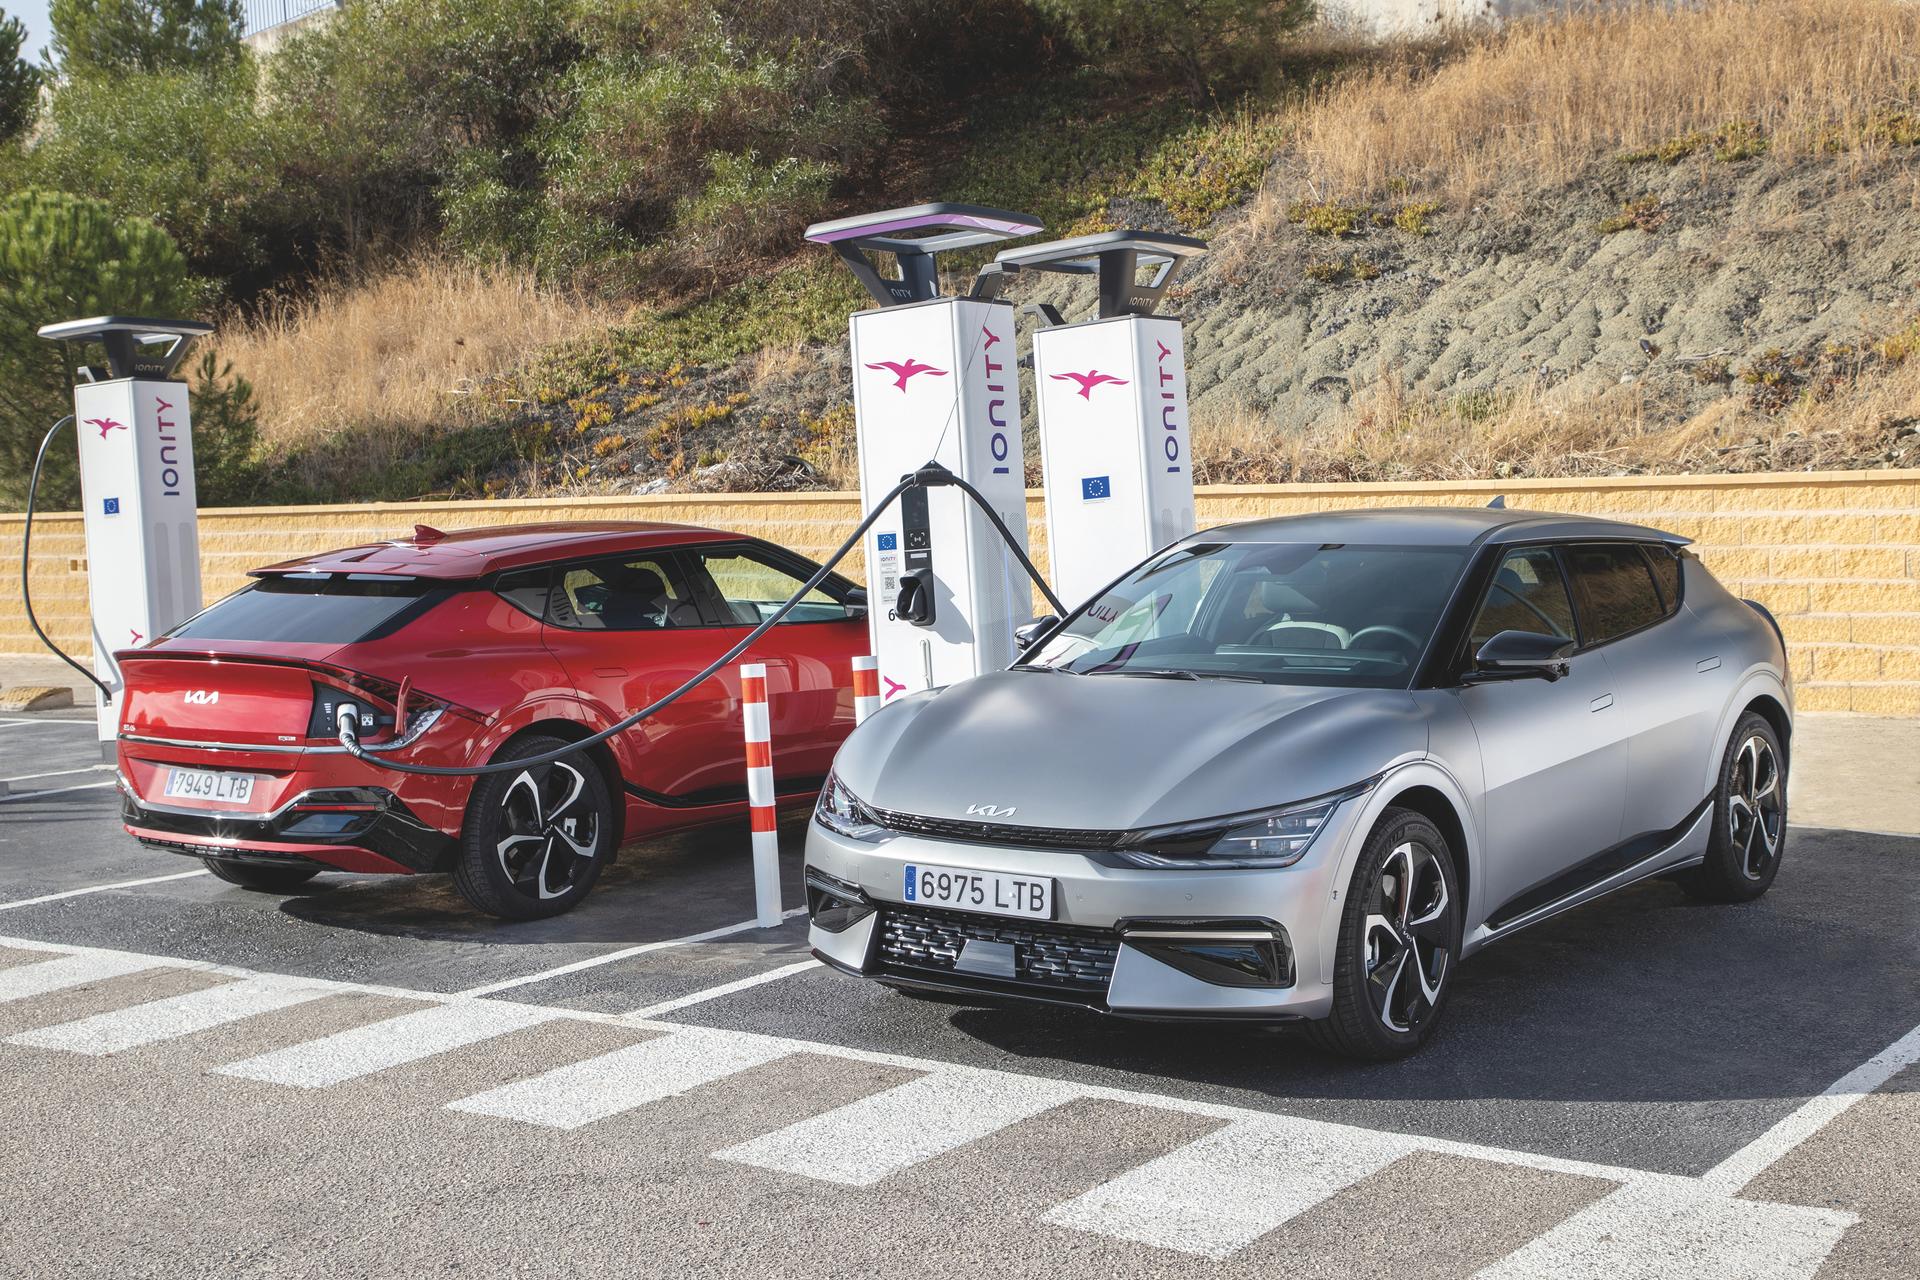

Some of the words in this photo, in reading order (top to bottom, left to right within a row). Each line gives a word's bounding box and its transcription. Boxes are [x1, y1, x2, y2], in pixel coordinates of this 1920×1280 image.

[1129, 296, 1153, 307] IONITY
[134, 363, 166, 373] IONITY
[982, 325, 1010, 475] IONITY
[1156, 338, 1181, 473] IONITY
[156, 396, 180, 496] IONITY
[888, 608, 896, 621] 6
[183, 690, 220, 704] KIA
[176, 773, 213, 795] 7949
[216, 776, 249, 798] LTB
[966, 803, 1018, 818] KIA
[921, 871, 985, 905] 6975
[995, 879, 1045, 912] LTB
